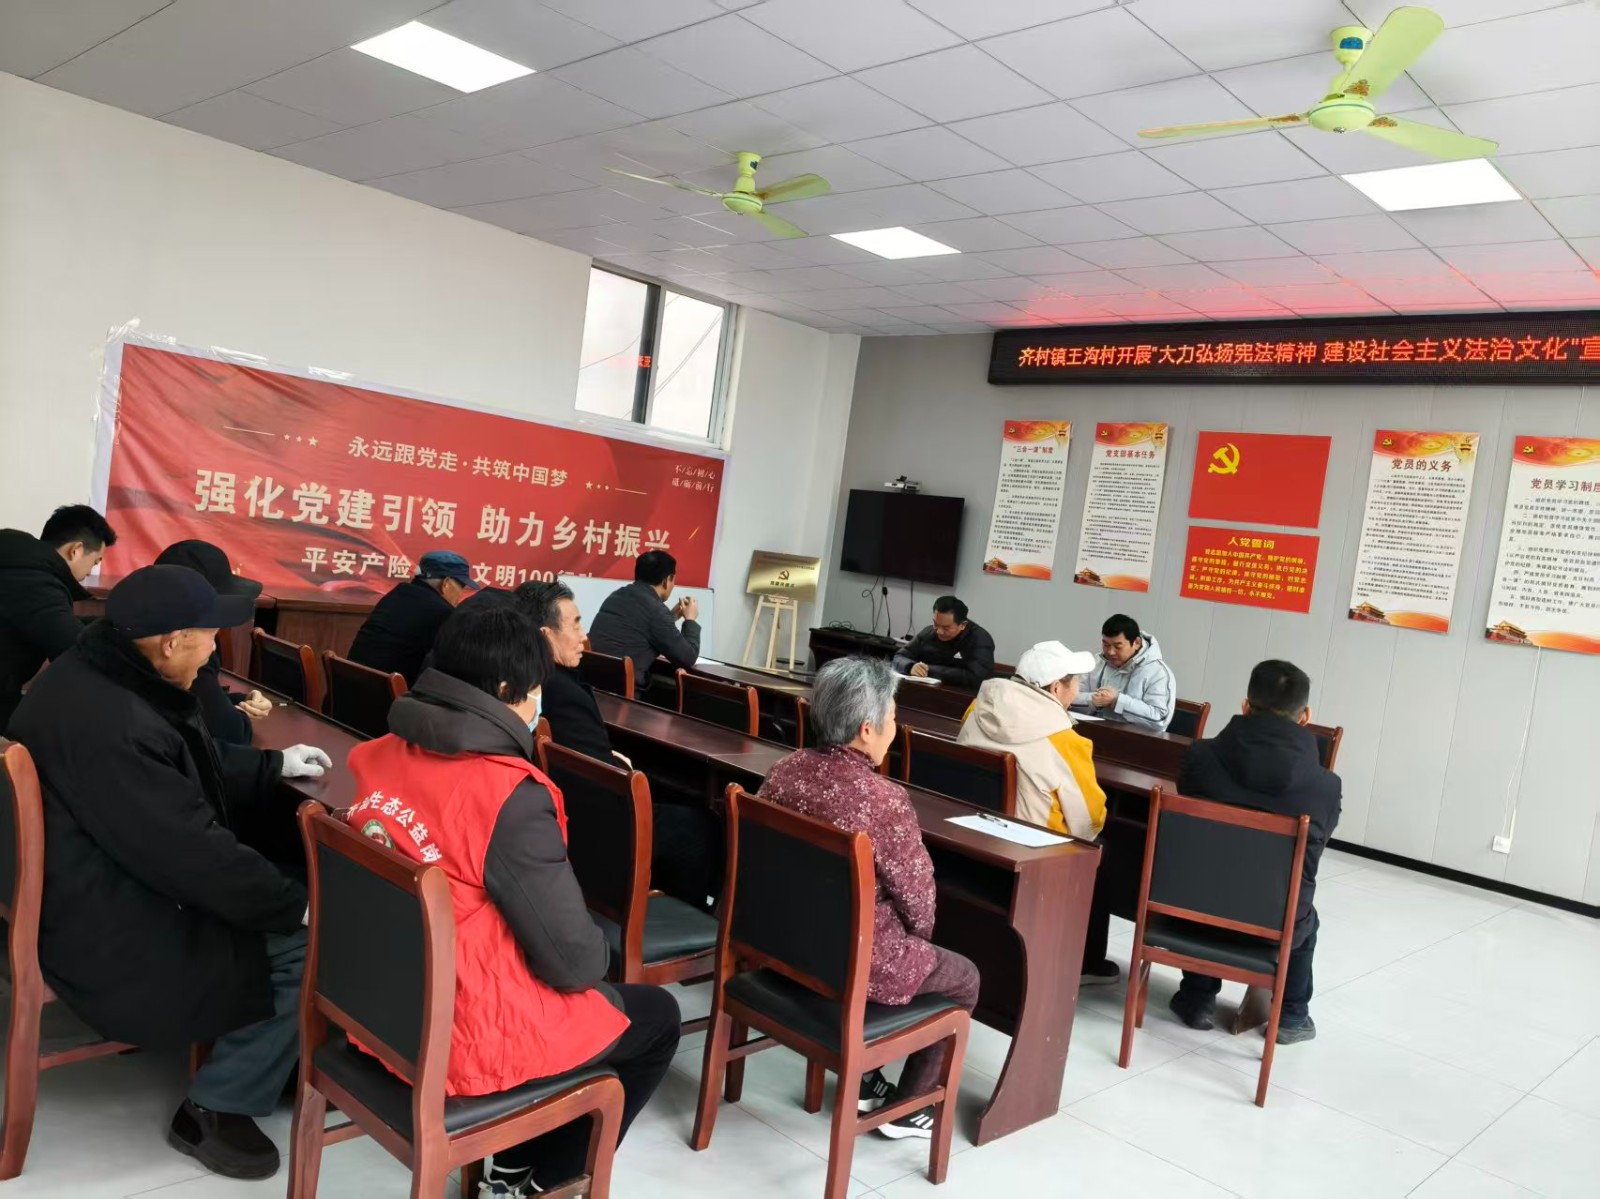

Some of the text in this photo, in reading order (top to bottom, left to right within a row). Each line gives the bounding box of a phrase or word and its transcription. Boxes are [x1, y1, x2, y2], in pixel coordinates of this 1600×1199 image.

[1391, 458, 1452, 472] 党员的义务
[194, 468, 670, 558] 强化党建引领 助力乡村振兴
[1227, 536, 1275, 550] 入党誓词
[301, 546, 593, 588] 平安产险 文明100
